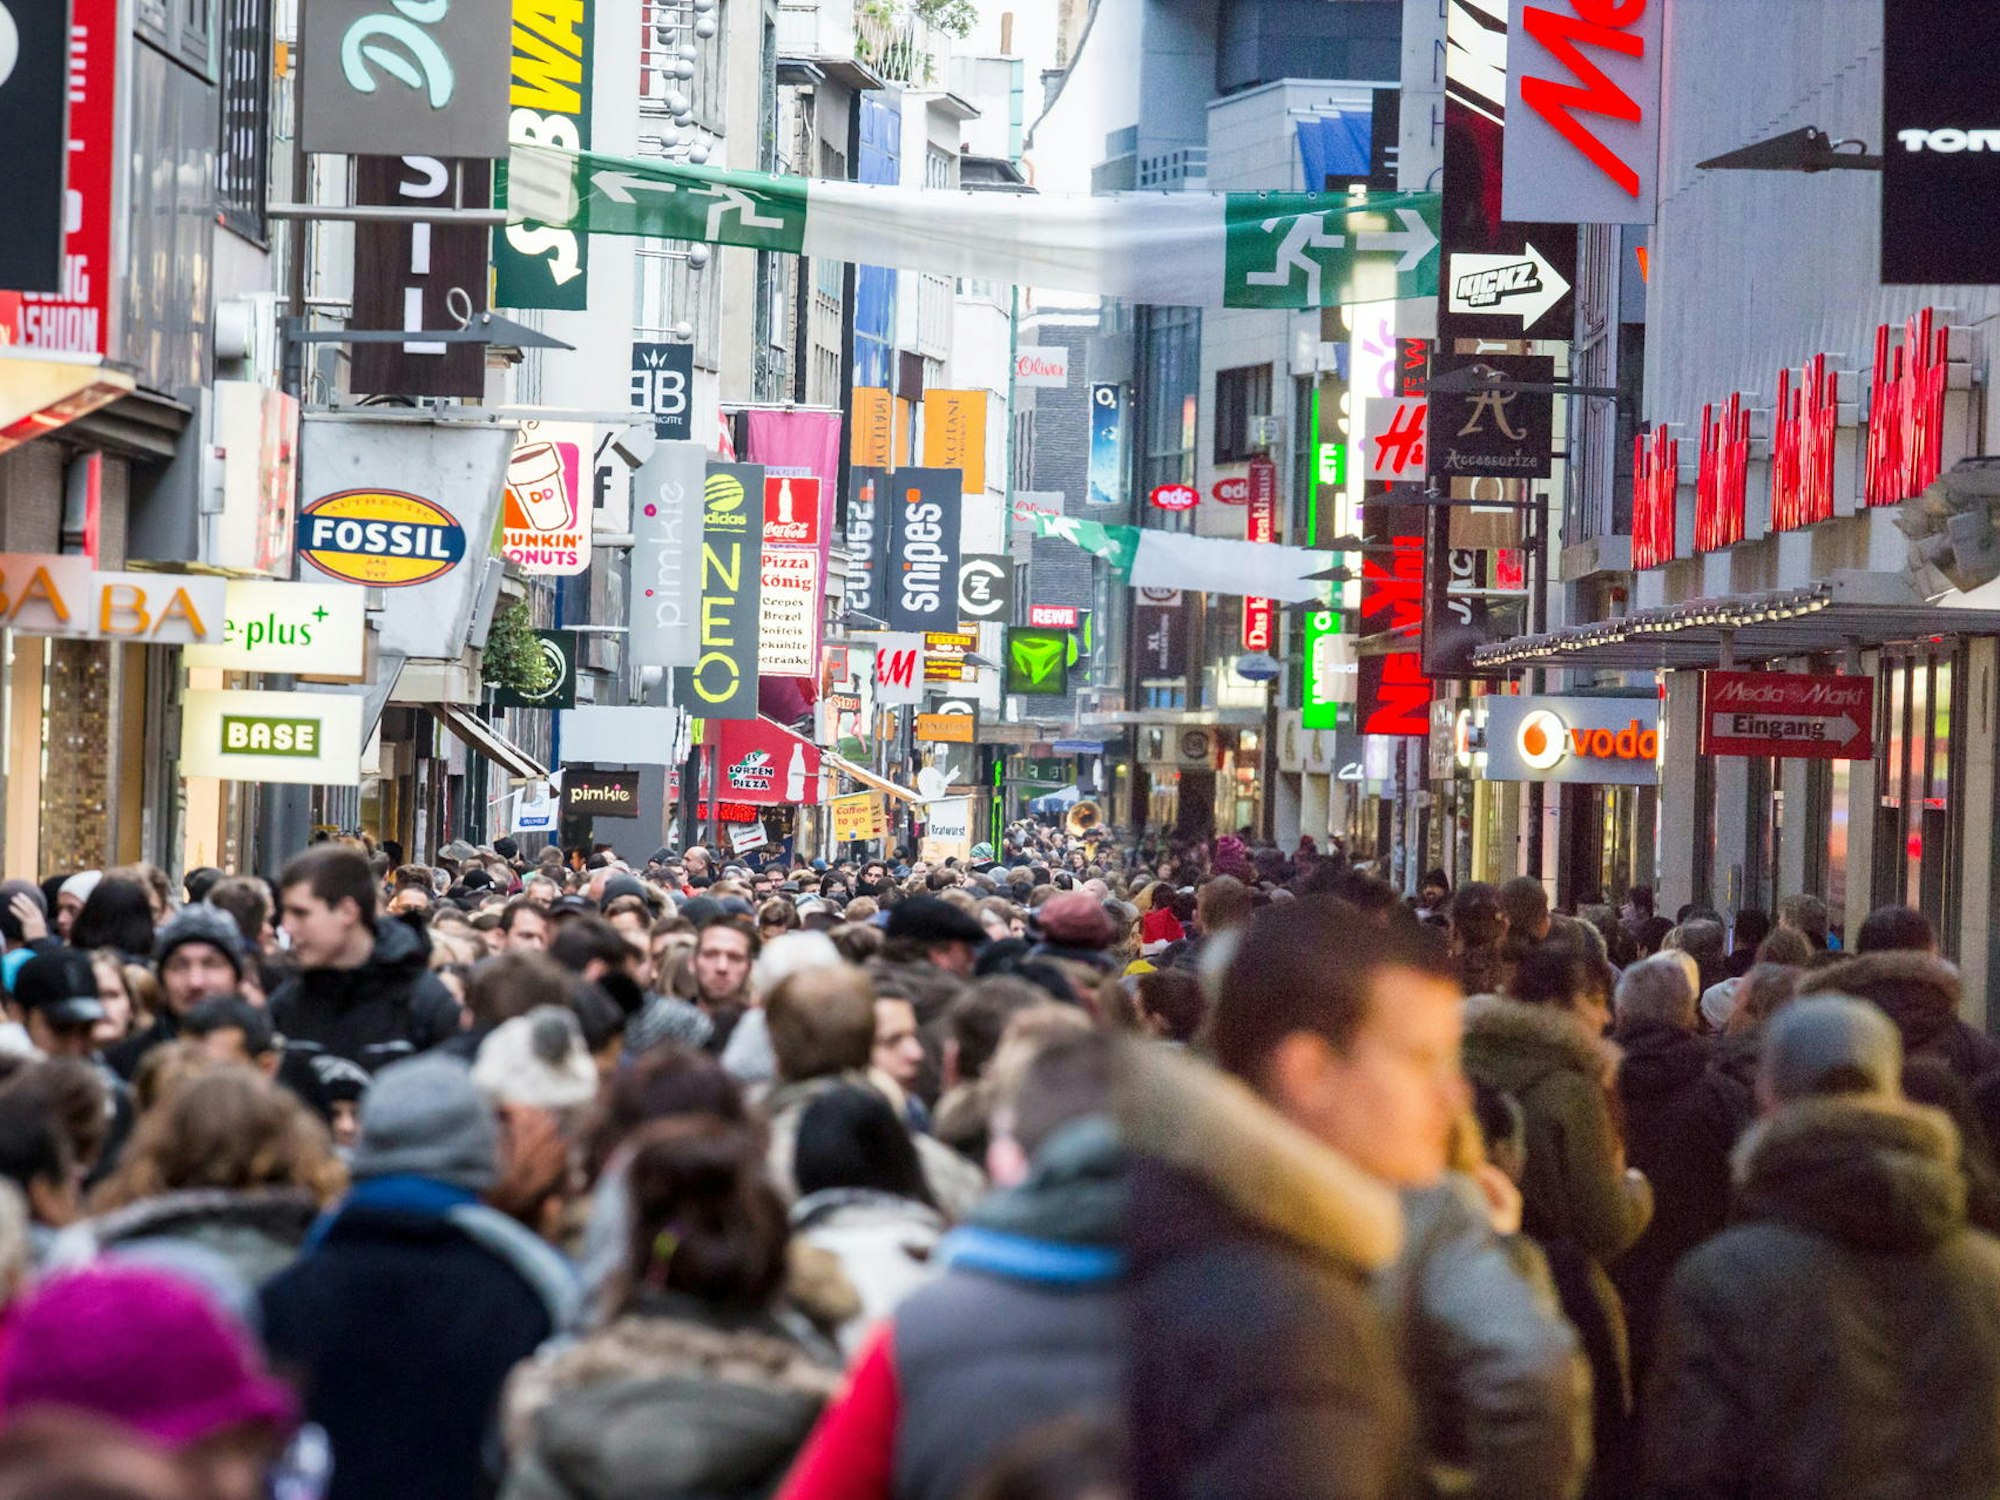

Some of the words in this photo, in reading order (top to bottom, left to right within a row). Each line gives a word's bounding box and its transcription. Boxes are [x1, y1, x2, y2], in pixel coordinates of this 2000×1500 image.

[1157, 487, 1193, 505] edc
[1253, 468, 1271, 543] teakhaus
[312, 518, 450, 559] FOSSIL
[761, 555, 809, 569] Pizza
[901, 503, 948, 613] snipes
[692, 542, 741, 703] NEO
[1032, 608, 1075, 625] REWE
[1250, 613, 1268, 648] Das
[1715, 681, 1785, 703] Media
[228, 722, 314, 751] BASE
[1733, 714, 1826, 740] Eingang
[571, 783, 630, 803] pimkie
[733, 779, 768, 789] PIZZA
[836, 806, 868, 815] Coffee
[931, 824, 965, 836] Bratwurst
